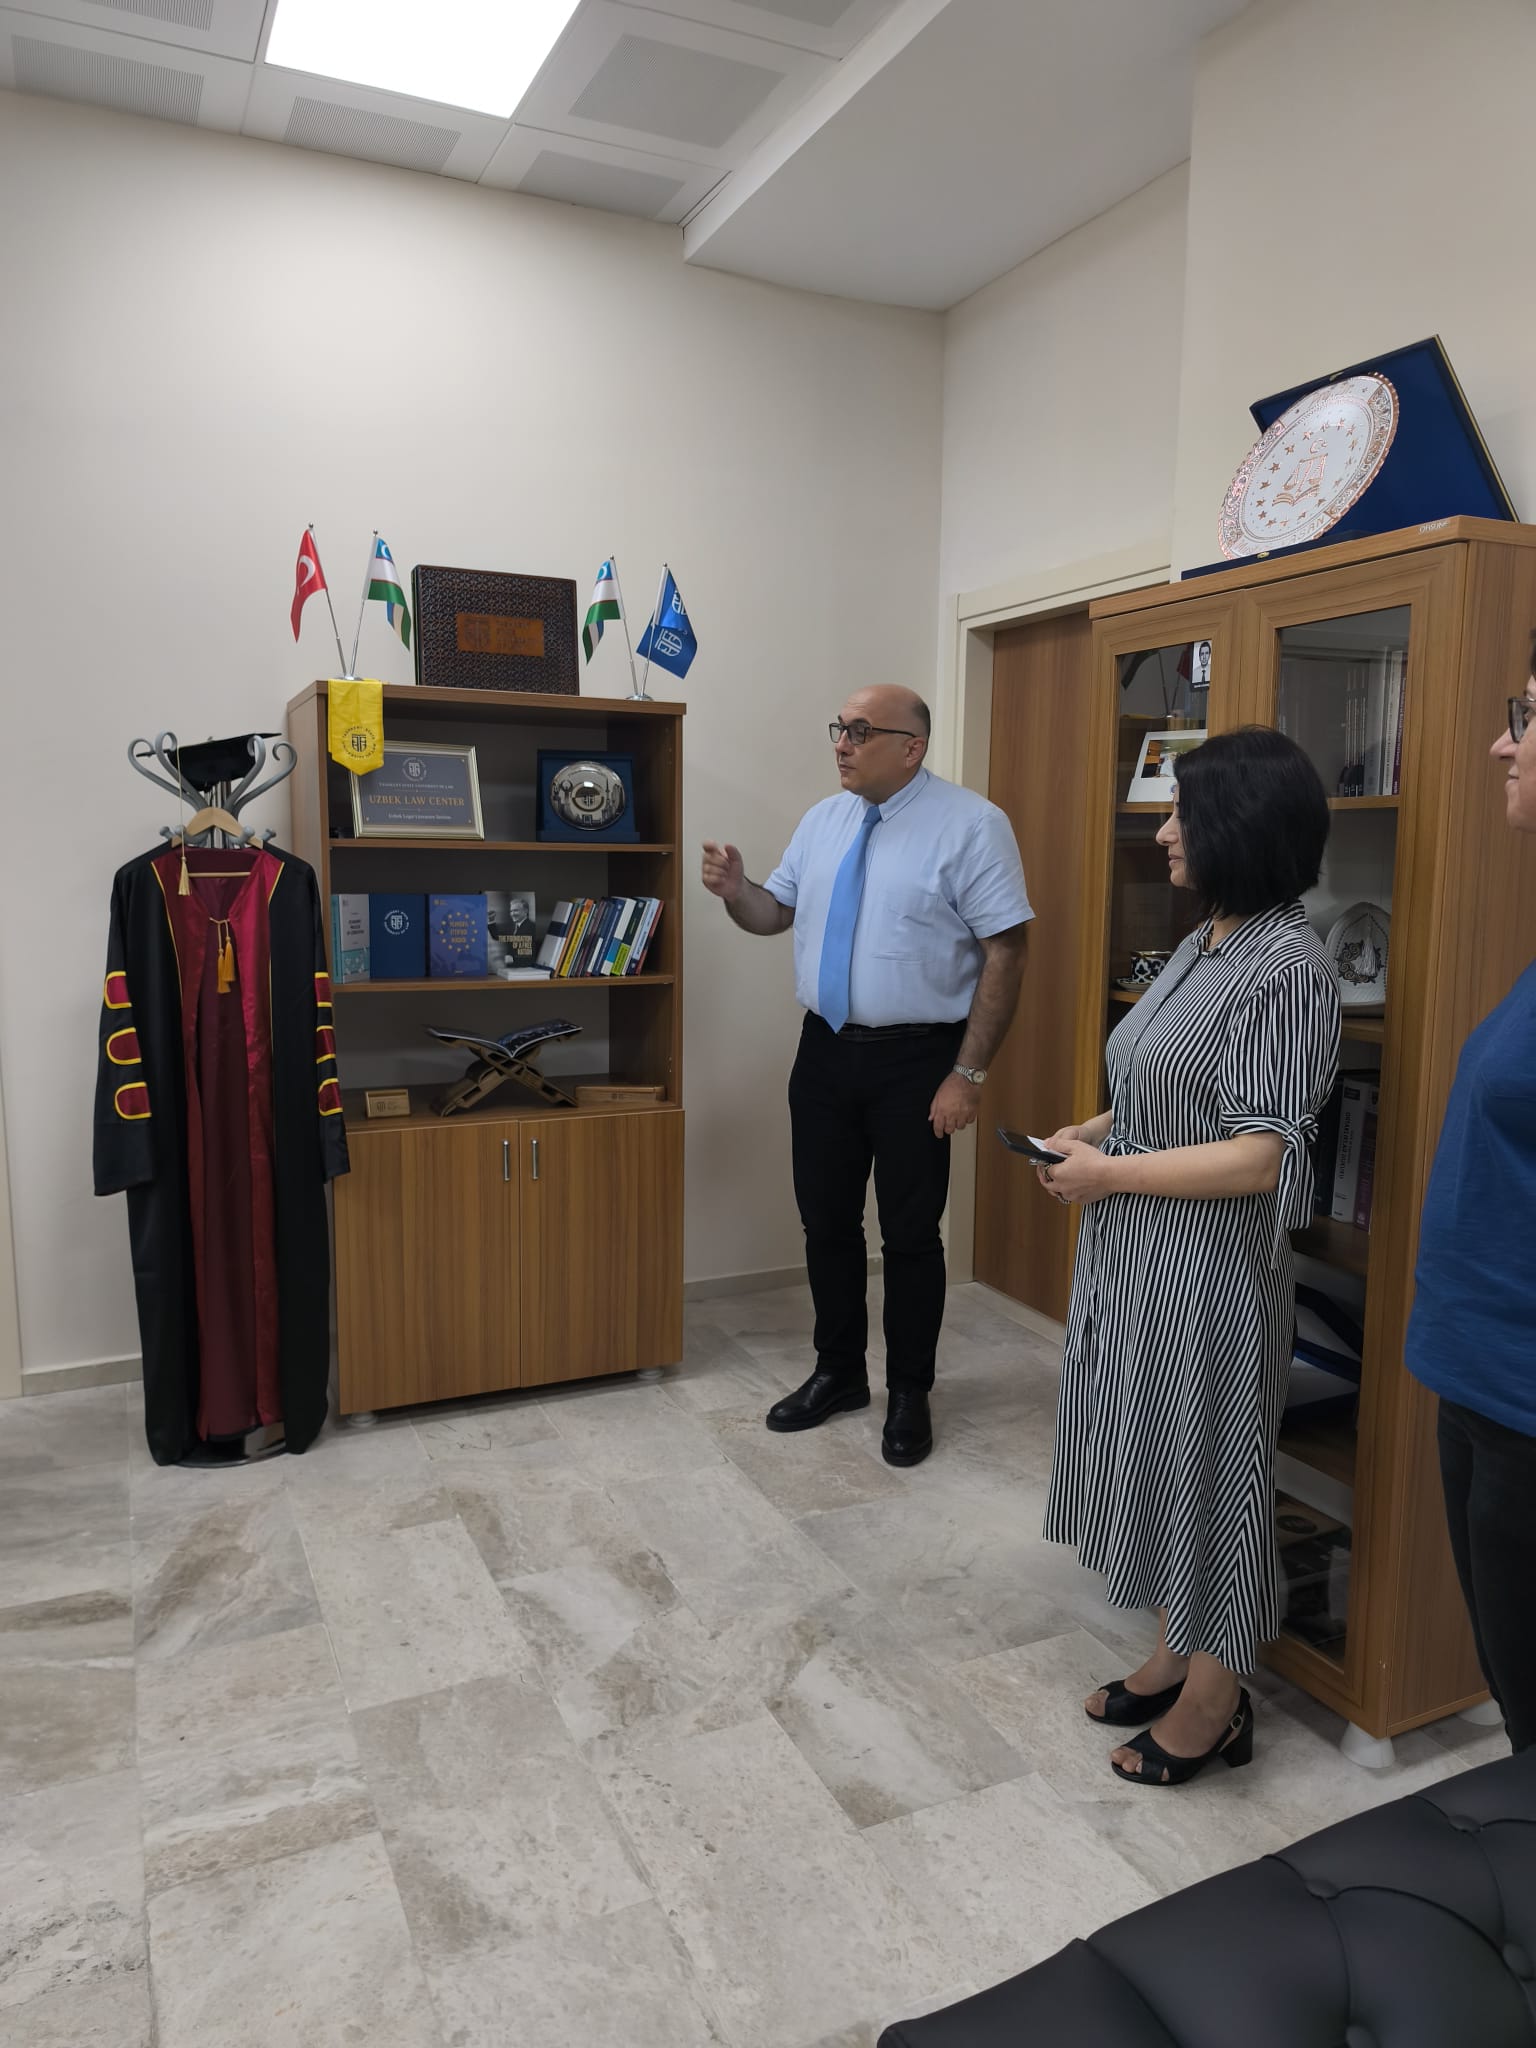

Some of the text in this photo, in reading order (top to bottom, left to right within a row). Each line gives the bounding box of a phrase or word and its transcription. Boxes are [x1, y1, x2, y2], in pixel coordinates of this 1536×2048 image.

[369, 794, 465, 807] UZBEK LAW CENTER
